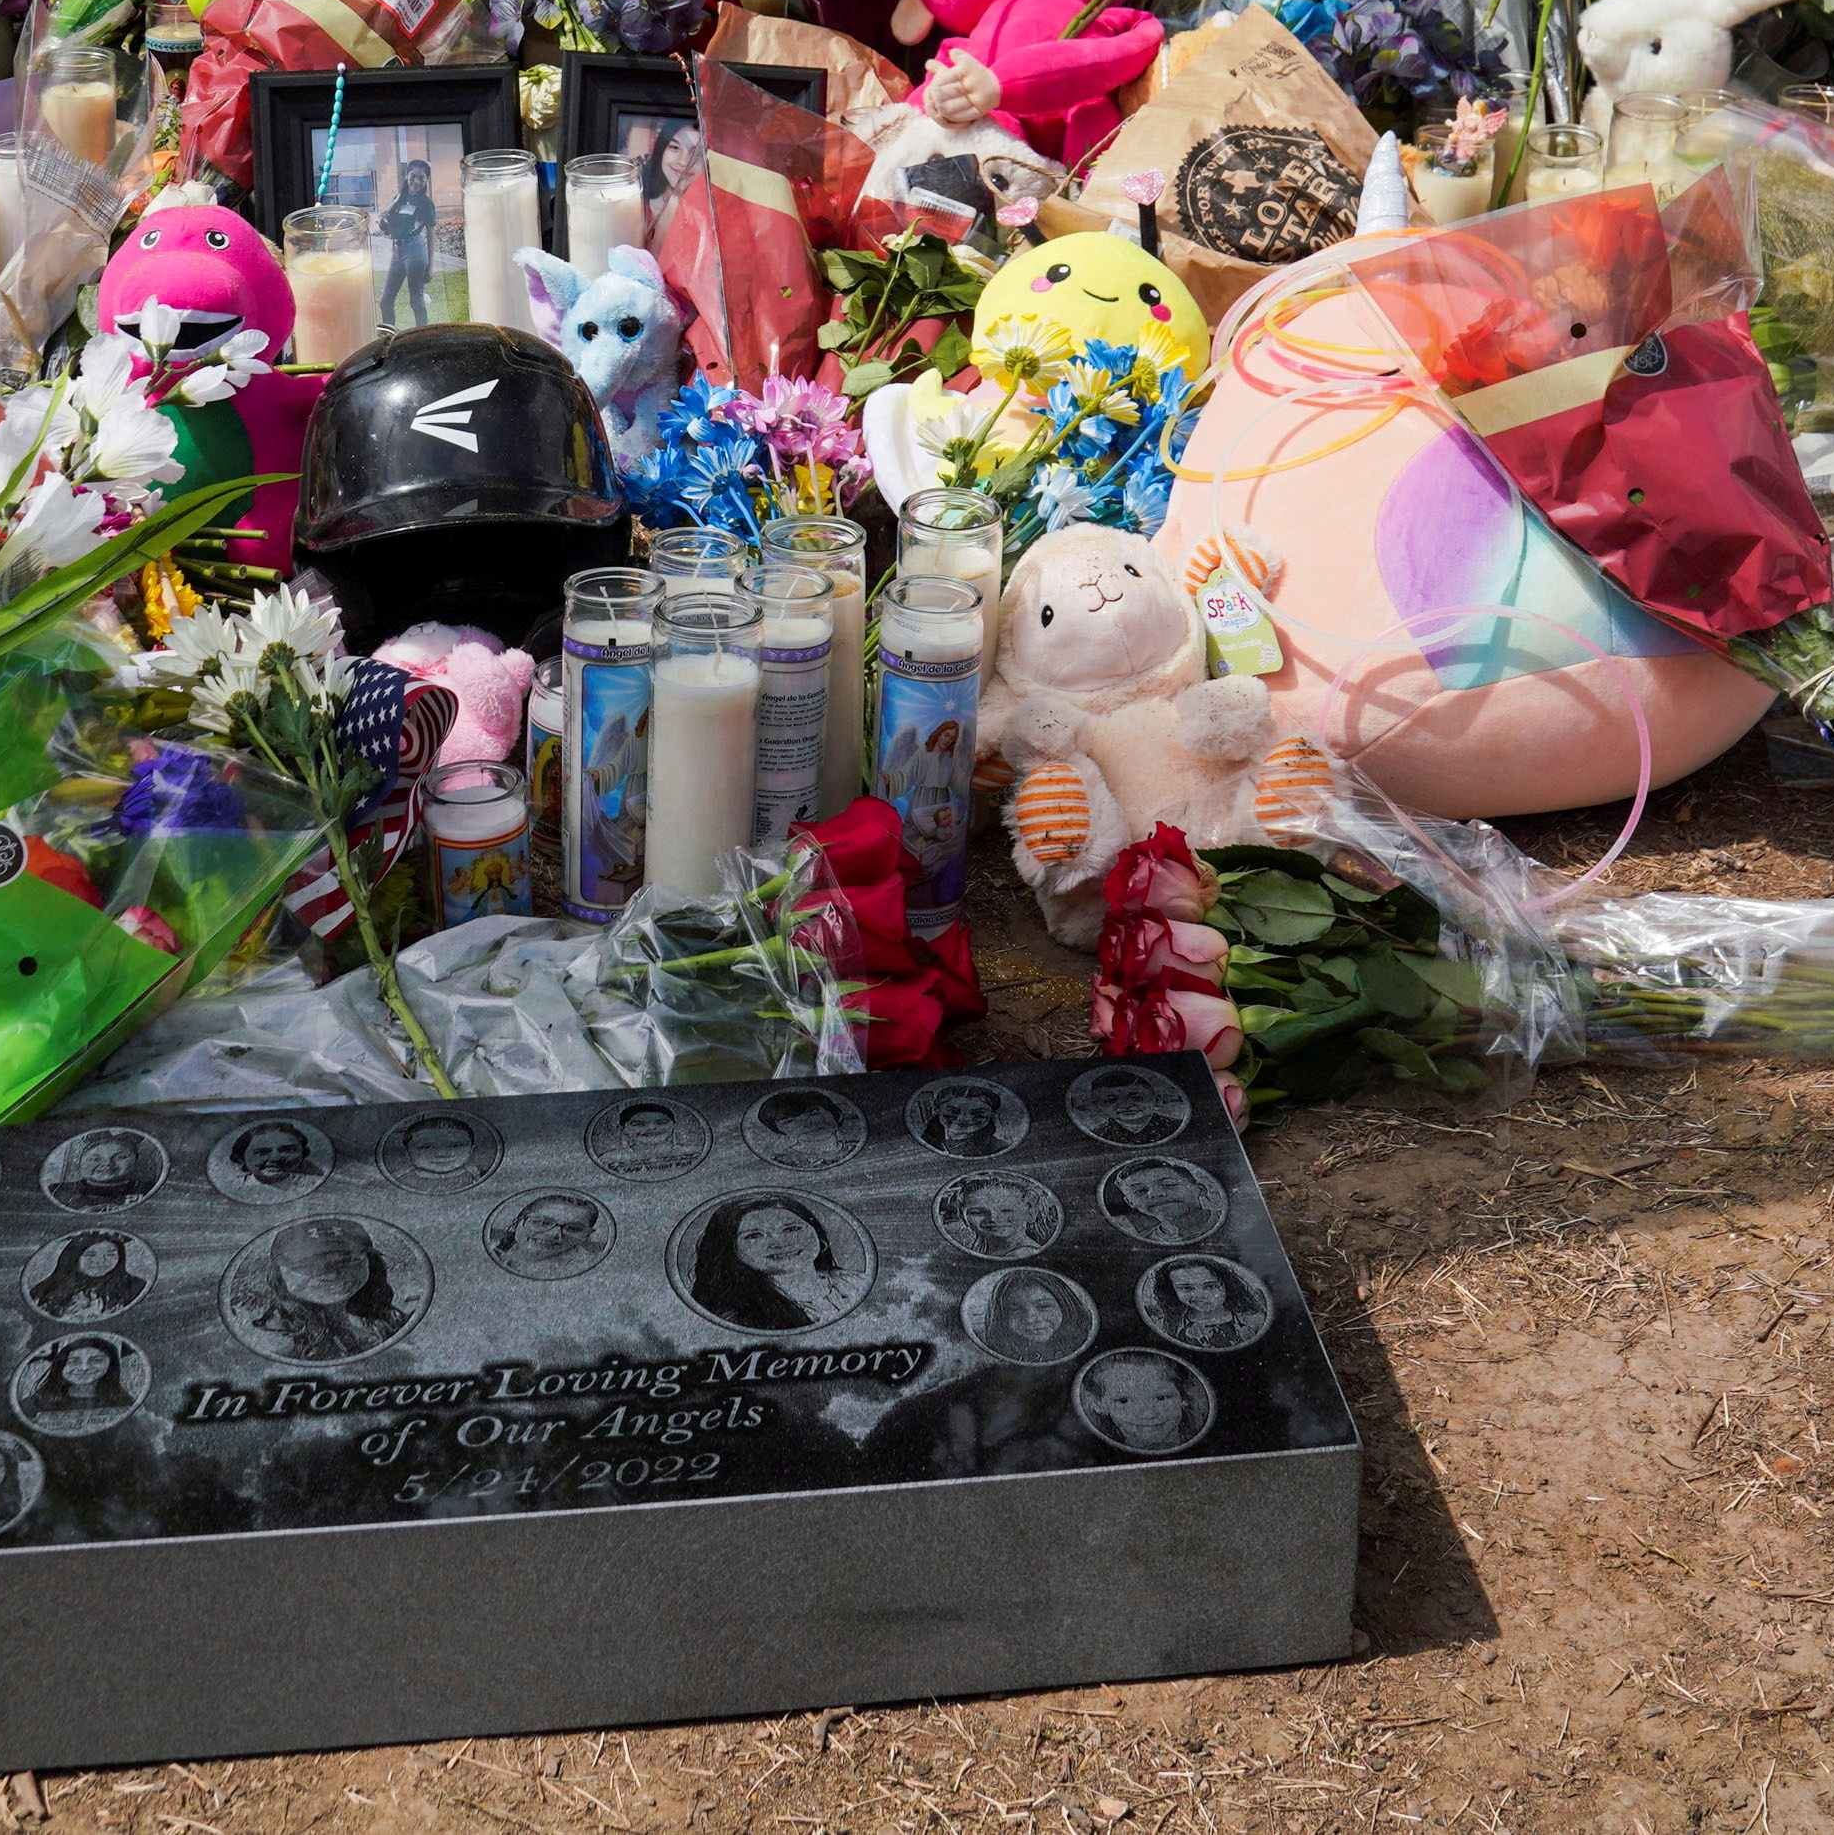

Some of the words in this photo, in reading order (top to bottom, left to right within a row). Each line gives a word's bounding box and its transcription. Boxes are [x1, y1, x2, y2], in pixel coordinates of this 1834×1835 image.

[1196, 184, 1214, 224] FOR
[1239, 159, 1315, 254] LONE
[1267, 175, 1341, 264] STAR
[632, 645, 644, 657] de
[928, 662, 942, 674] de
[943, 662, 953, 674] la
[784, 691, 794, 701] de
[796, 690, 805, 701] la
[764, 735, 799, 747] Guardian
[187, 1385, 249, 1422] In
[268, 1376, 473, 1416] Forever
[487, 1360, 688, 1406] Loving
[701, 1344, 926, 1383] Memory
[359, 1420, 427, 1462] of
[456, 1414, 567, 1449] Our
[582, 1396, 765, 1446] Angels
[392, 1452, 722, 1505] 5/24/2022
